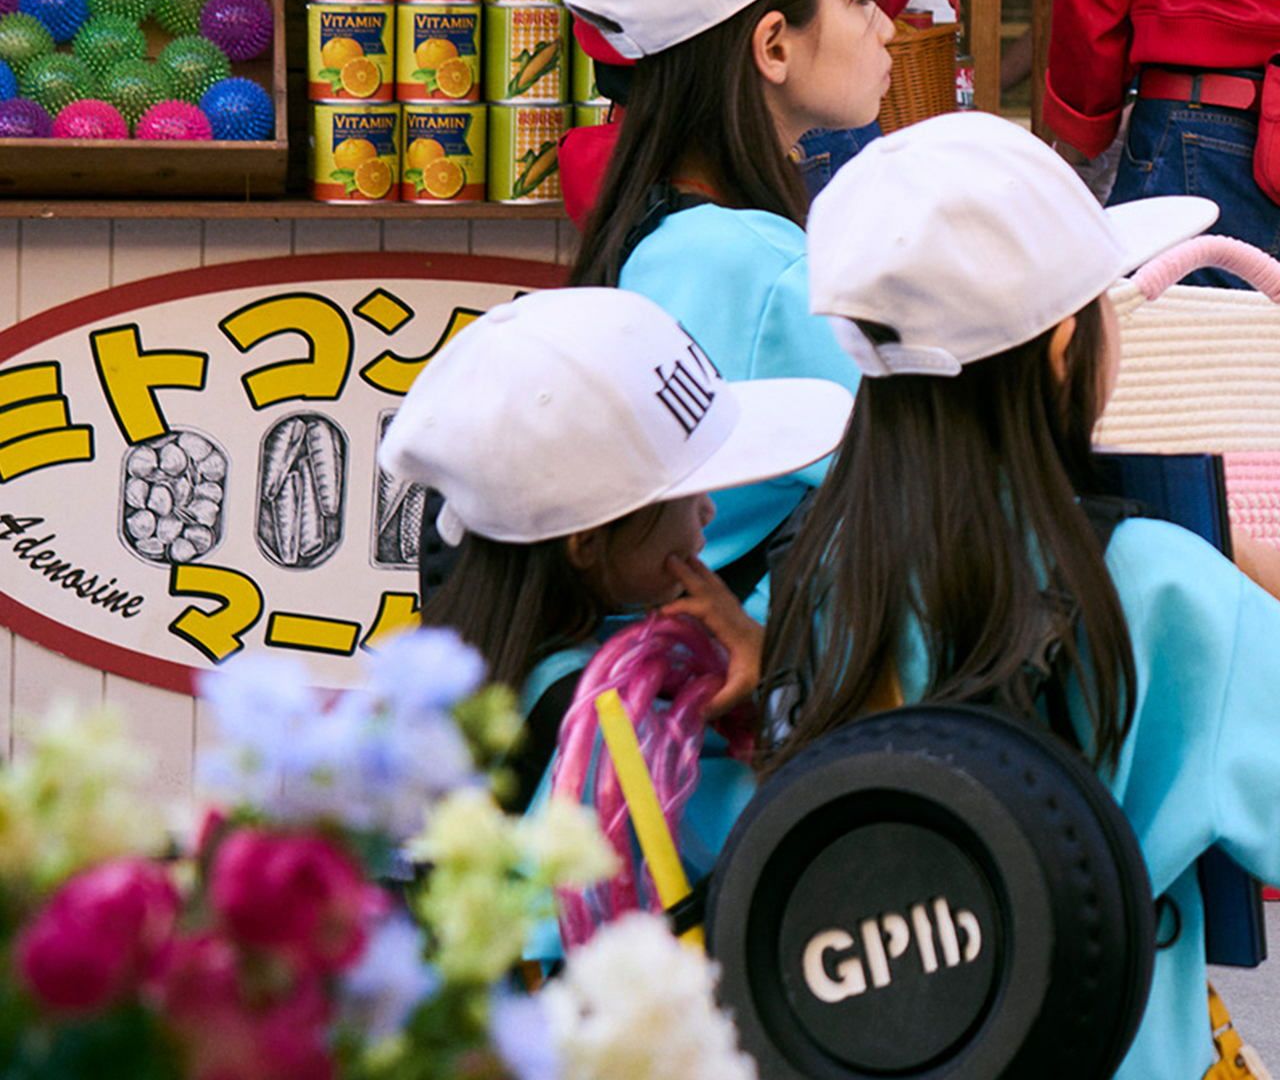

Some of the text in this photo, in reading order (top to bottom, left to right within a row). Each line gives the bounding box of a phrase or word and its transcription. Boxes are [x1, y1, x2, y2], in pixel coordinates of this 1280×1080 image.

[321, 14, 383, 29] VITAMIN
[415, 15, 474, 29] VITAMIN
[334, 114, 393, 130] VITAMIN
[407, 114, 466, 130] VITAMIN
[0, 287, 486, 482] ミトコン
[0, 513, 145, 619] Adenosine
